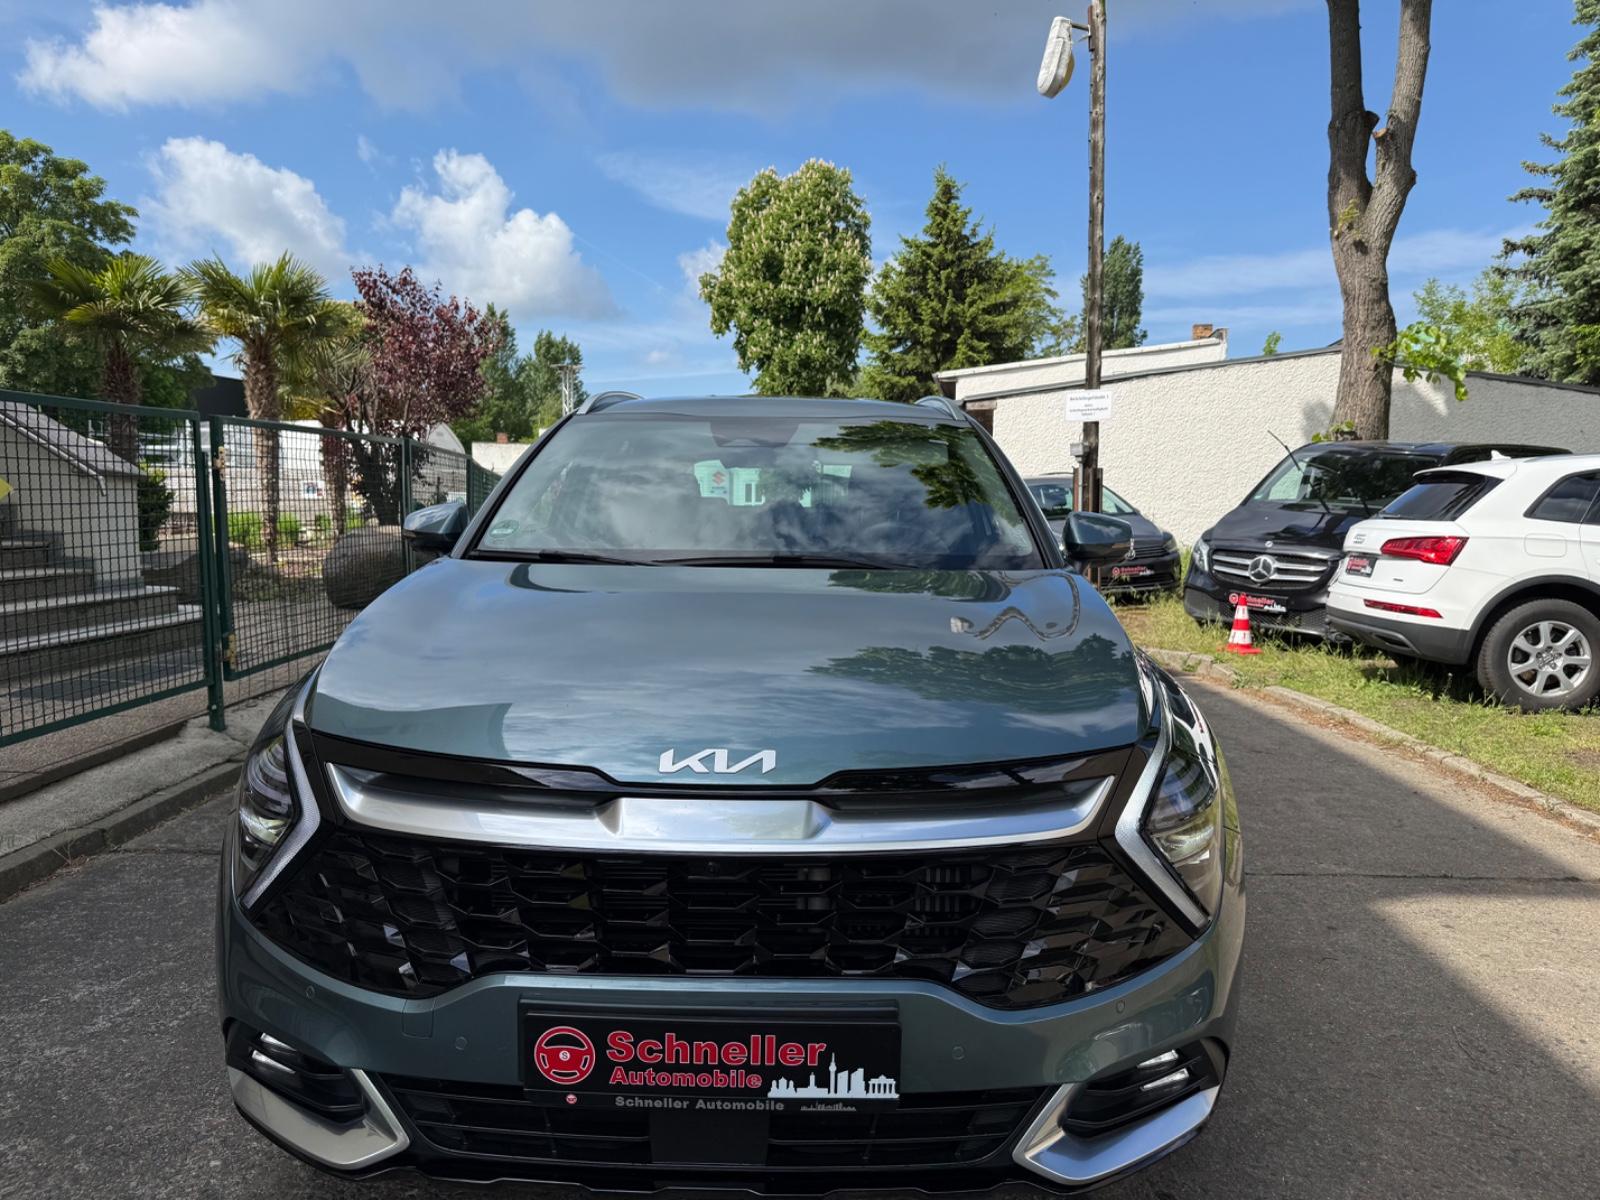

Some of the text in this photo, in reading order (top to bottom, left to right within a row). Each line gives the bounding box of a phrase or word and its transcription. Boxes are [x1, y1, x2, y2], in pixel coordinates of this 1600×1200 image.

[659, 748, 776, 774] KIA
[606, 1030, 827, 1066] Schneller
[609, 1066, 762, 1088] Automobile
[615, 1096, 785, 1111] Schneller Automobile
